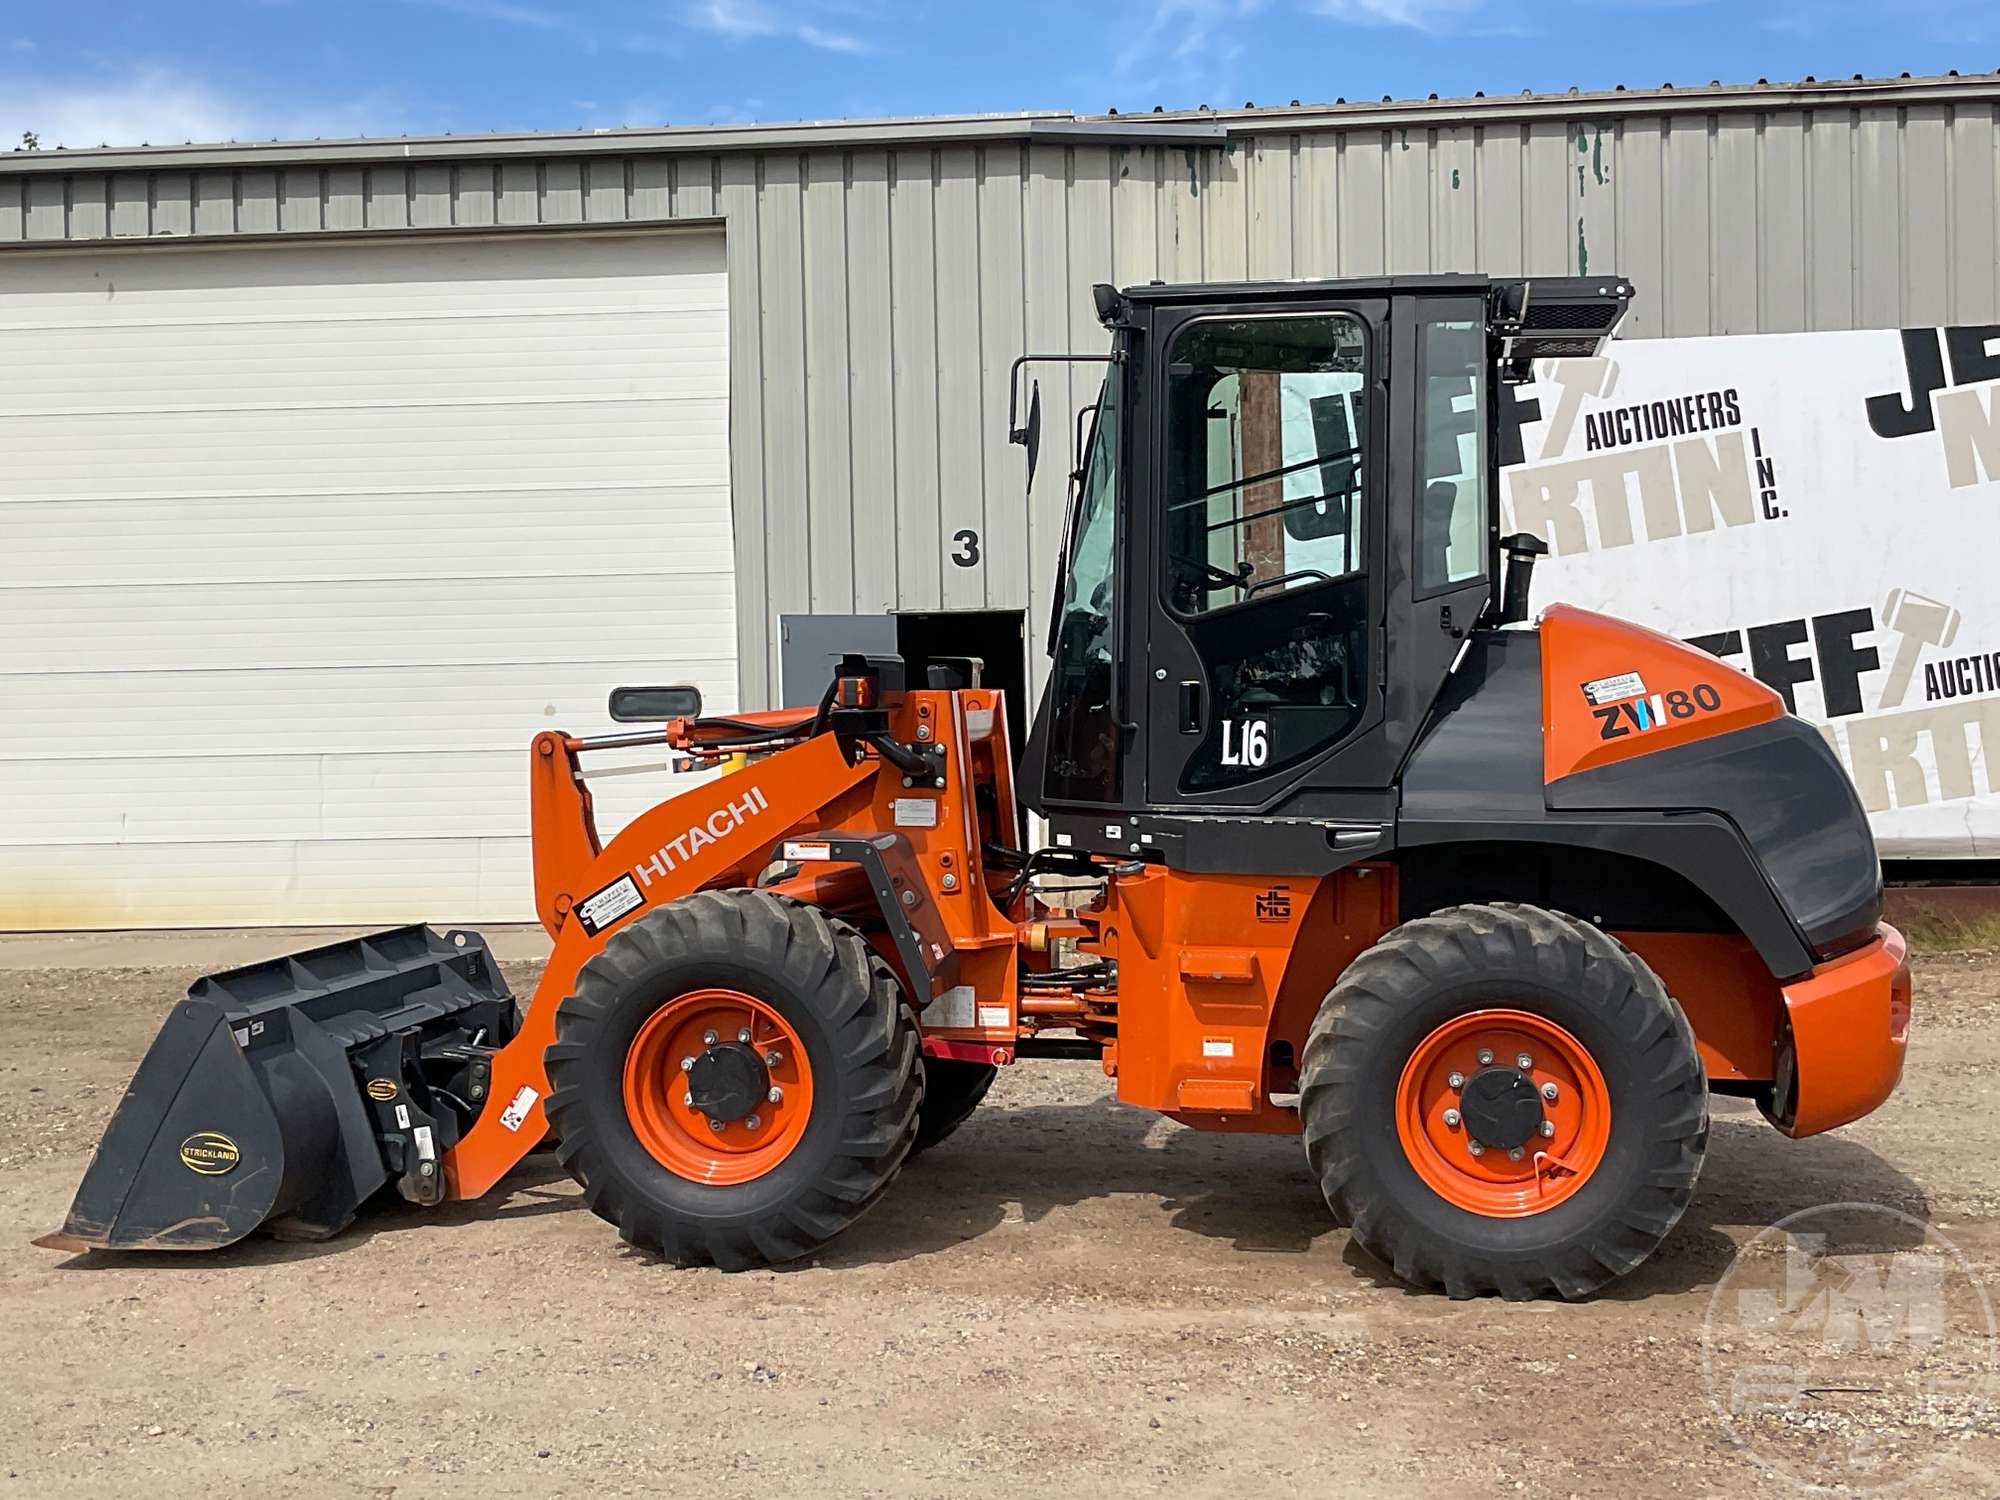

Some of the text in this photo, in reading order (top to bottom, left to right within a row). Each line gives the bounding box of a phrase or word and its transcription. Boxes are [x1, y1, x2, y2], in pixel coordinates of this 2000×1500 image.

[1585, 388, 1741, 451] AUCTIONEERS
[1750, 427, 1788, 520] INC.
[952, 529, 979, 567] 3
[1220, 720, 1267, 766] L16
[635, 786, 768, 886] HITACHI
[184, 1148, 235, 1160] STRICKLAND
